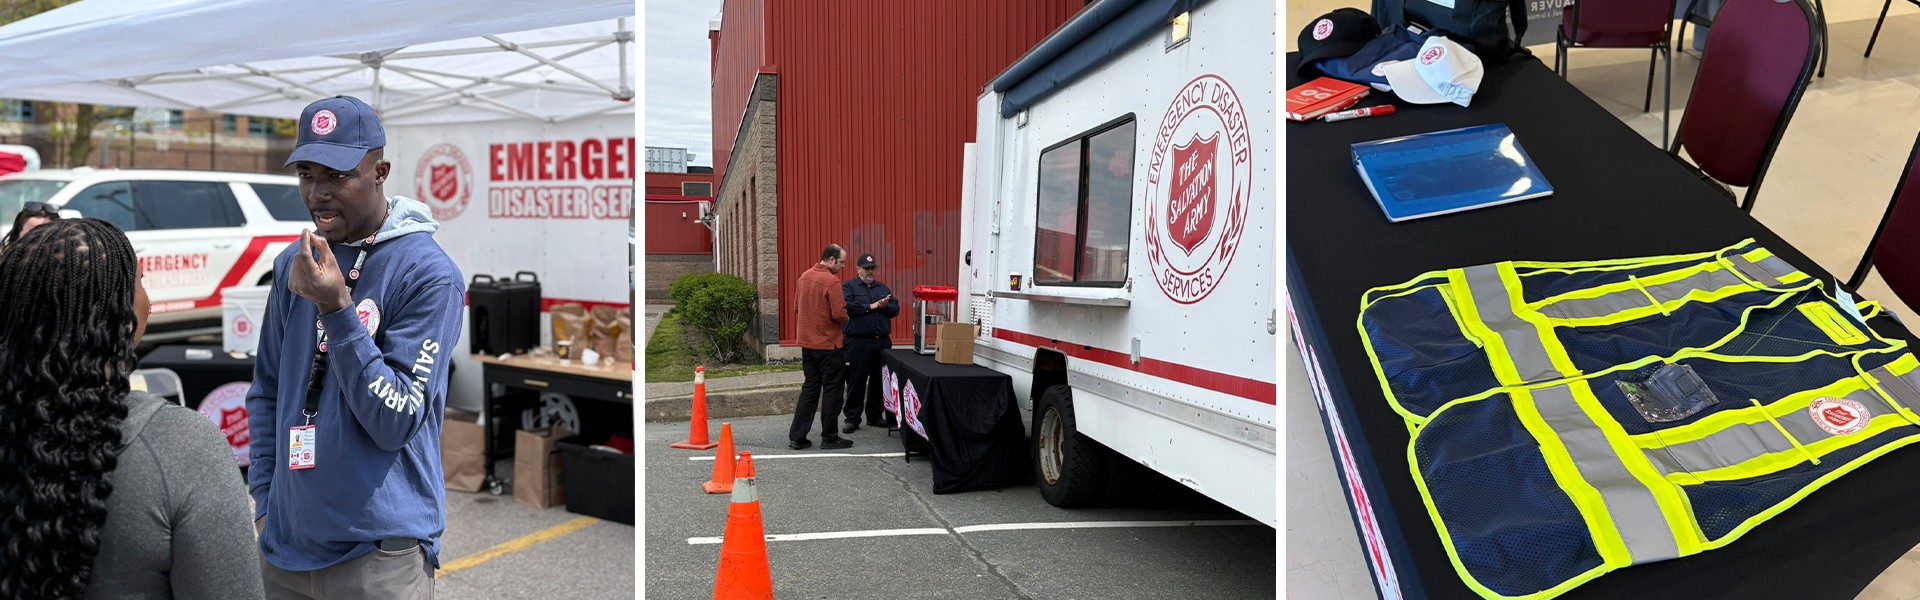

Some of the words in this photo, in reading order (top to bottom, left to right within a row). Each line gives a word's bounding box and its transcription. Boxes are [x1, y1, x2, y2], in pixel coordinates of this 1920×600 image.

[1149, 81, 1208, 185] EMERGENCY
[1211, 82, 1248, 167] DISASTER
[1179, 148, 1199, 187] THE
[489, 186, 589, 219] DISASTER
[1170, 152, 1213, 224] SALVATION
[1183, 186, 1211, 239] ARMY
[138, 253, 208, 272] MERGENCY
[1162, 267, 1213, 298] SERVICES
[368, 375, 409, 413] ARMY
